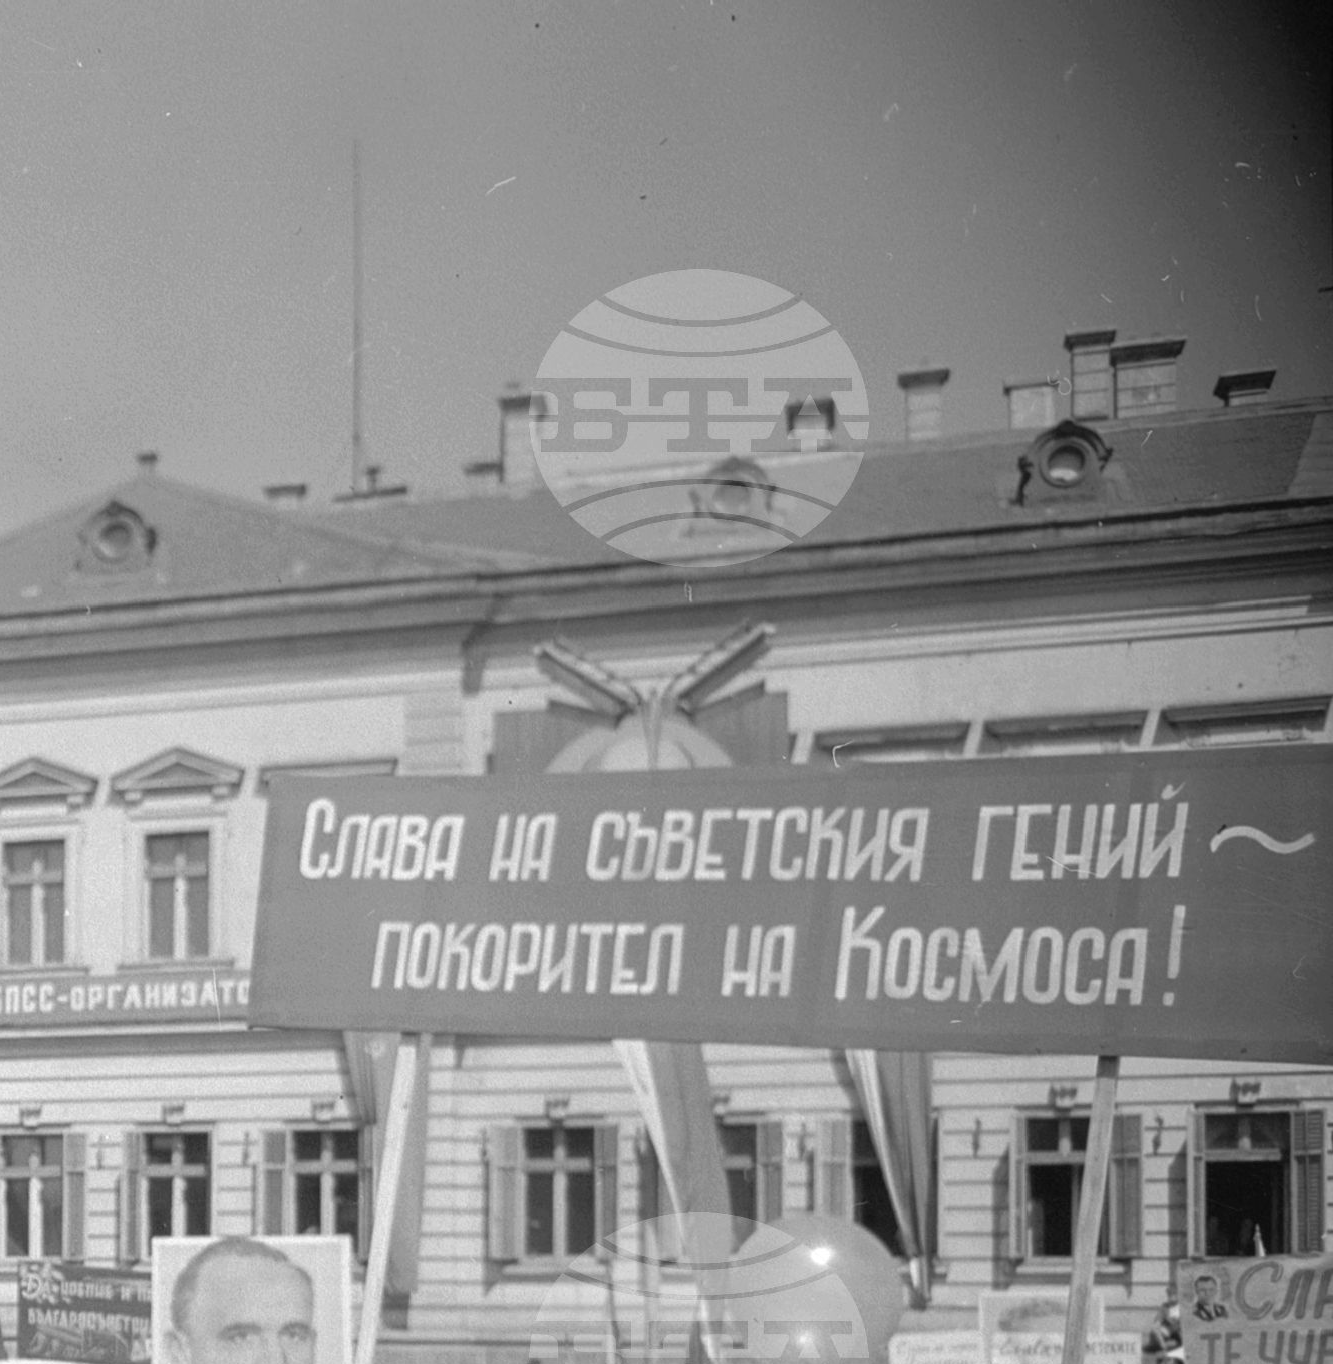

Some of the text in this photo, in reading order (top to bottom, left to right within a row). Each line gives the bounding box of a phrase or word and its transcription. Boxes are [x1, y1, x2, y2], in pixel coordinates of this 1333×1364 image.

[488, 813, 558, 882] НА
[585, 806, 929, 882] СЪВЕТСКИЯ
[972, 782, 1188, 881] ГЕНИЙ
[370, 920, 684, 996] ПОКОРИТЕЛ
[721, 924, 795, 998] НА
